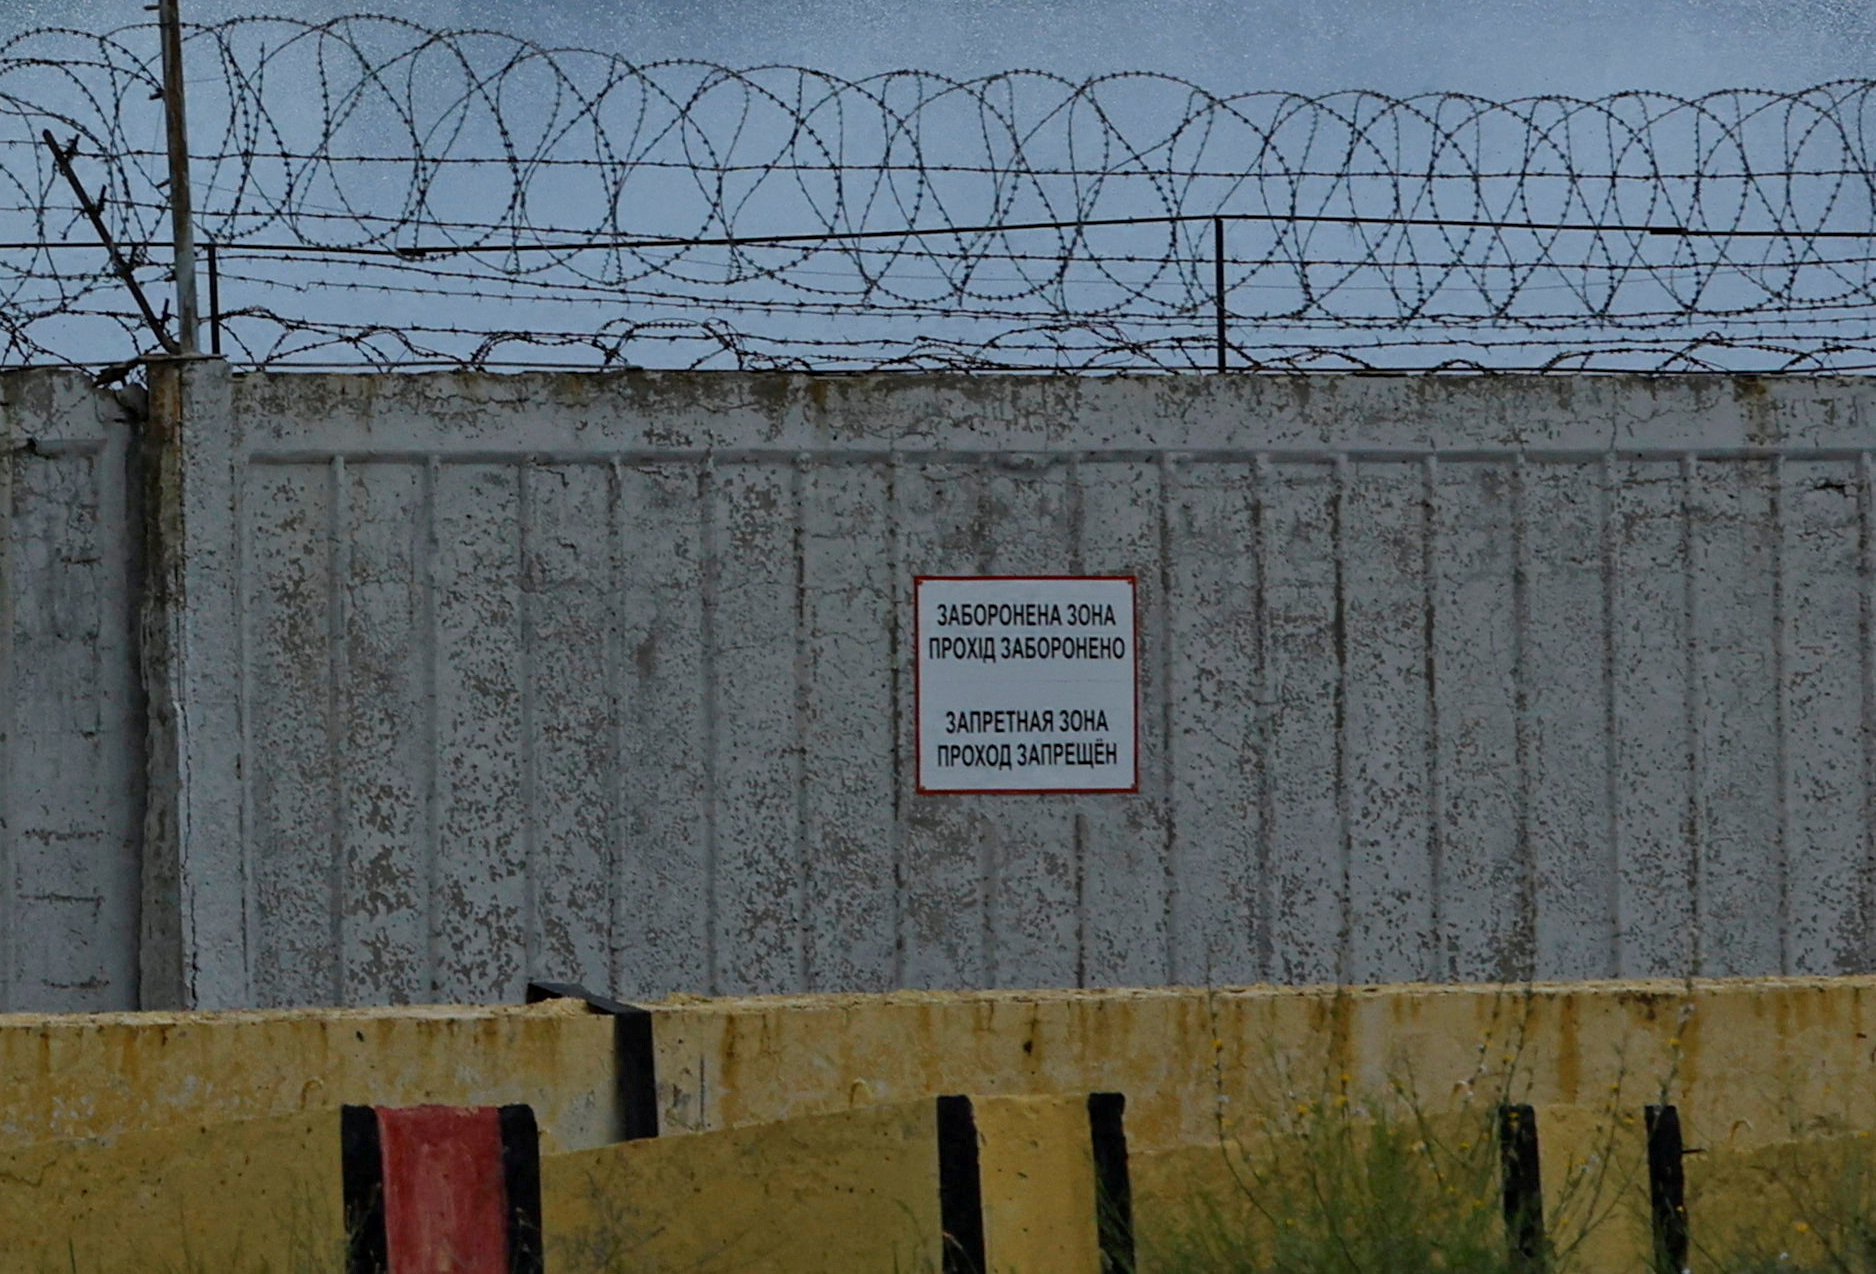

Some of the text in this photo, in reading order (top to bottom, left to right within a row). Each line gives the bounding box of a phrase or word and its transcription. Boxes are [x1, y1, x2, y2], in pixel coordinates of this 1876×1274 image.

[937, 604, 1116, 627] ЗАБОРОНЕНА ЗОНА
[929, 637, 1125, 663] ПРОХІД ЗАБОРОНЕНО
[946, 710, 1109, 734] ЗАПРЕТНАЯ ЗОНА
[938, 738, 1117, 770] ПРОХОД ЗАПРЕЩЁН
